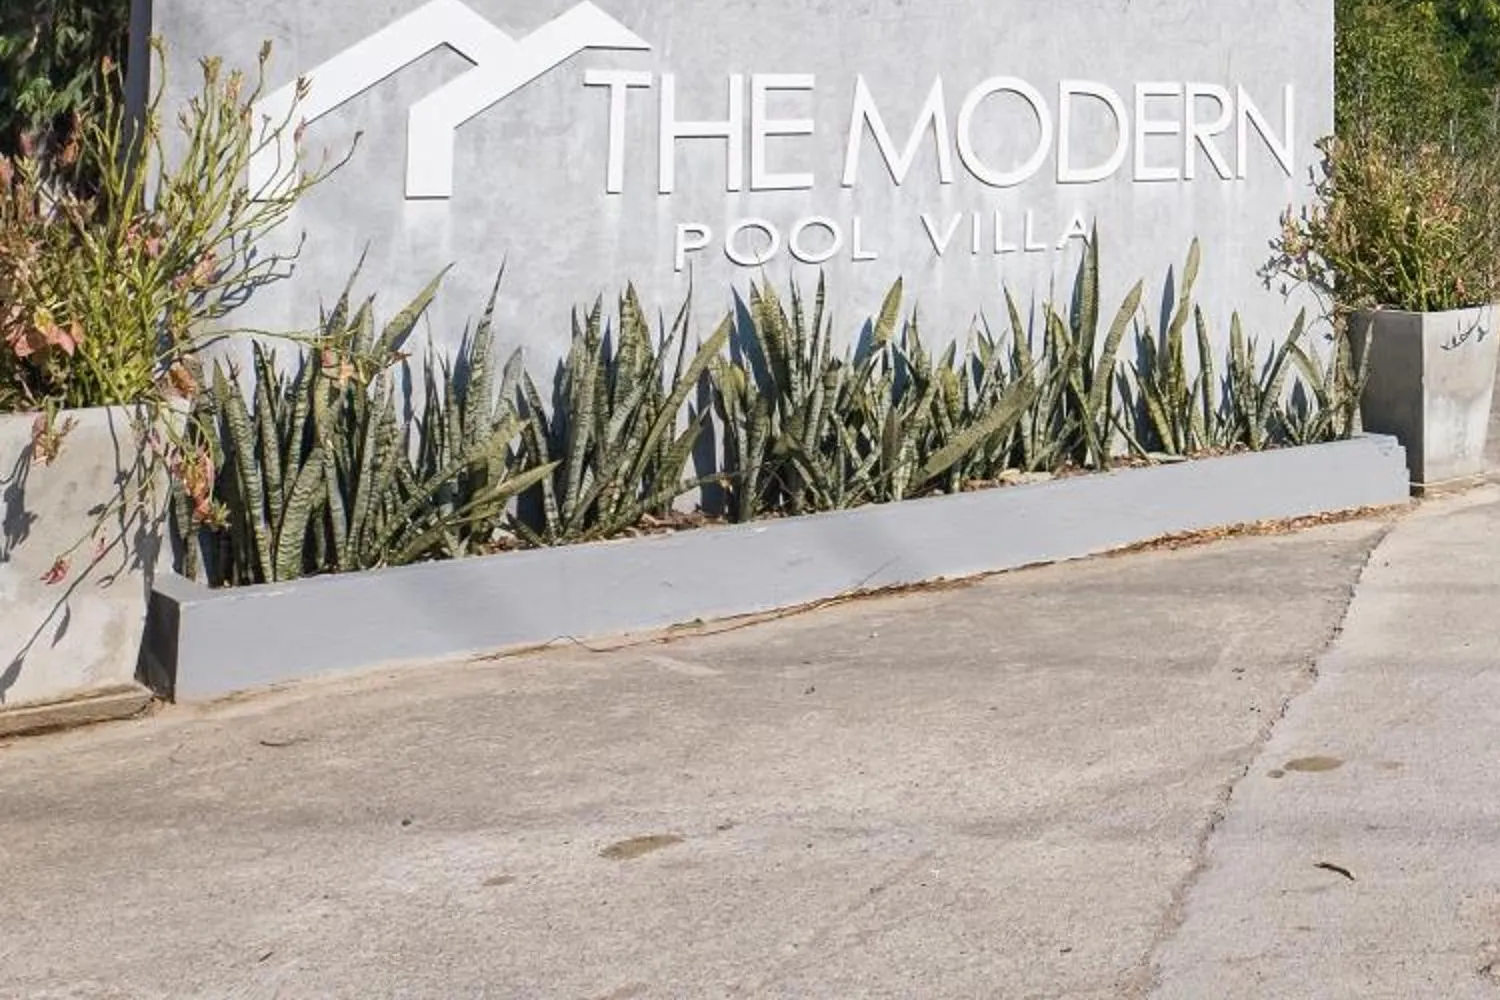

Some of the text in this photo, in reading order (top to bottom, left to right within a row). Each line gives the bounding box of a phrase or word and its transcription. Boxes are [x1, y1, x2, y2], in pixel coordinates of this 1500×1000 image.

[584, 70, 1293, 193] THE MODERN
[674, 209, 1093, 272] POOL VILLA
